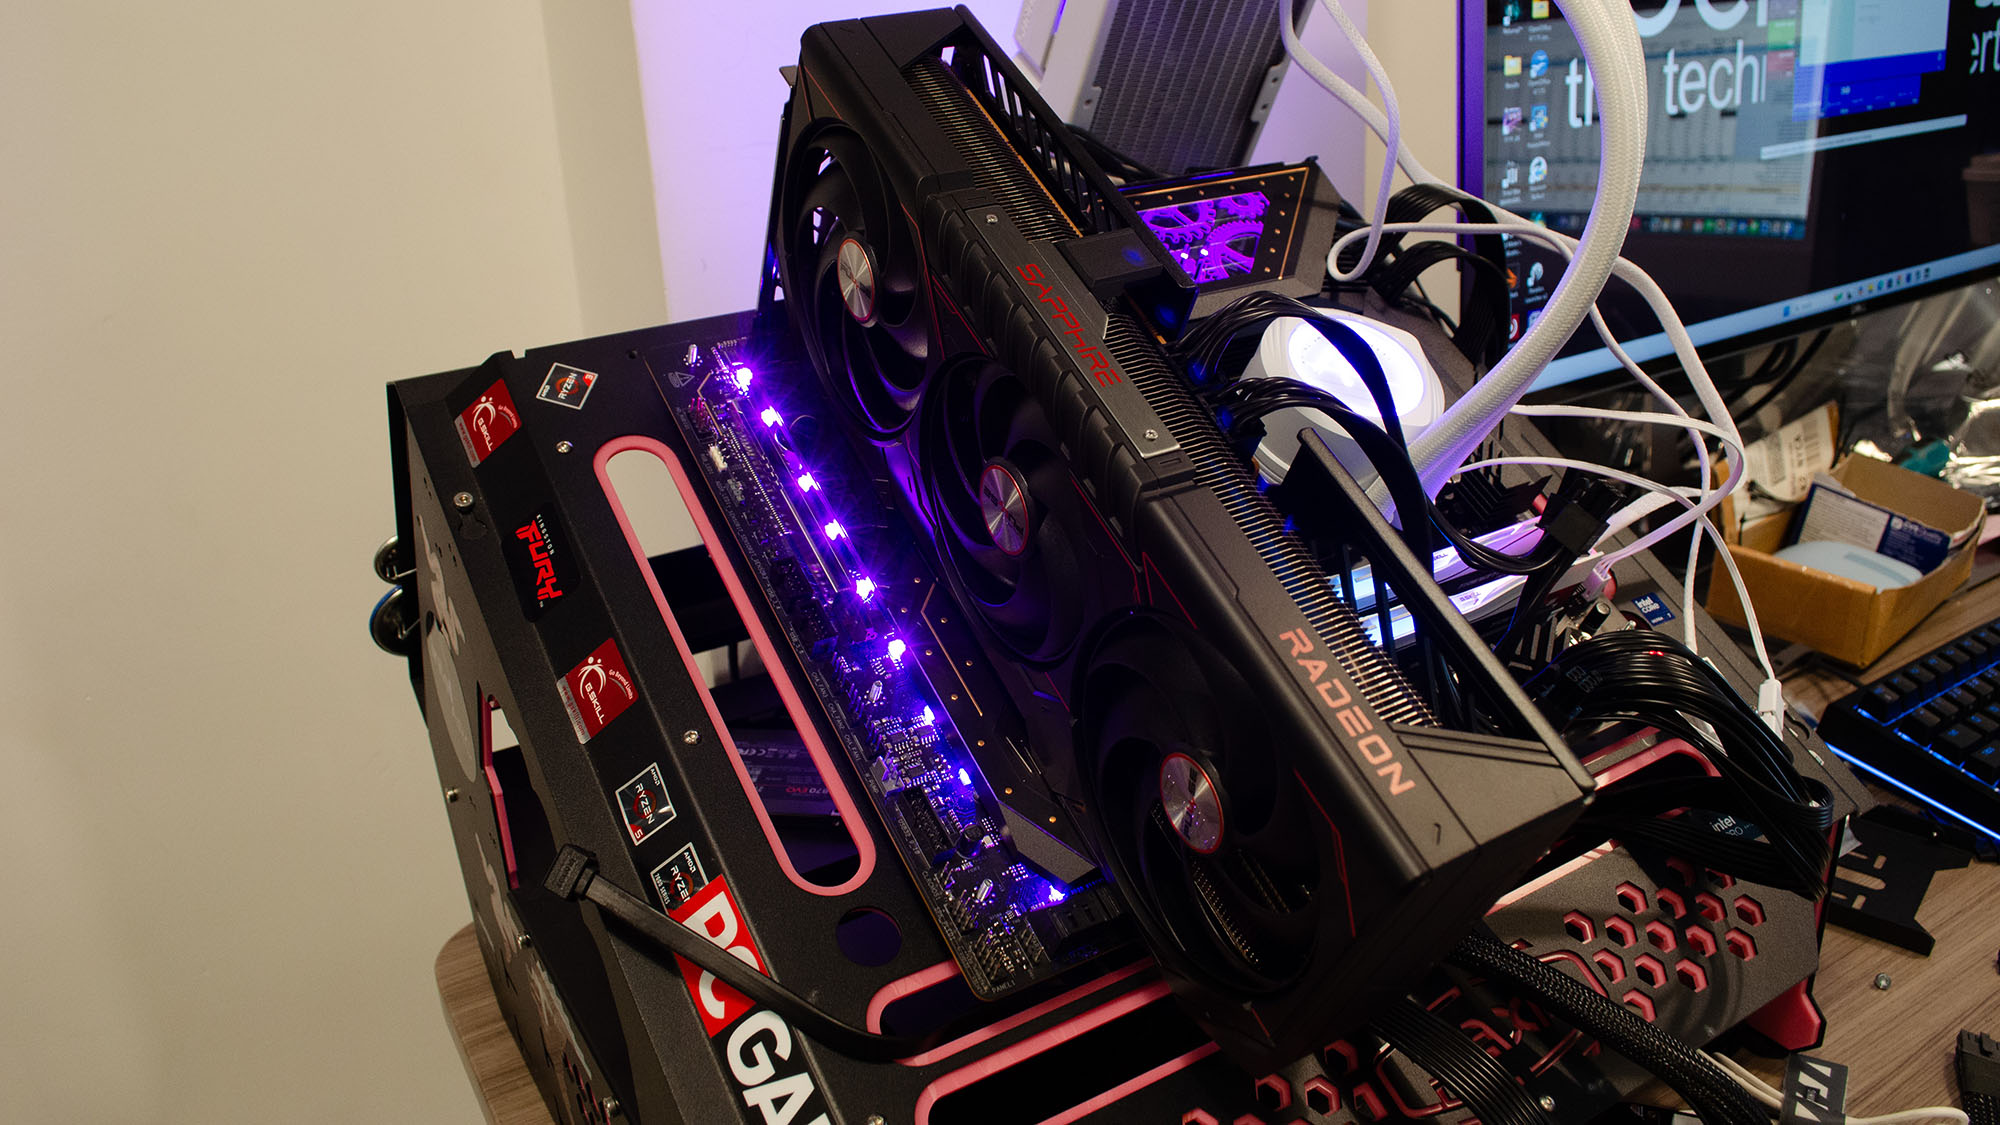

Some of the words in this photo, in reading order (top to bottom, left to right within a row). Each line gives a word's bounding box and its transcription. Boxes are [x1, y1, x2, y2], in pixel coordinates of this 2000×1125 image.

[1016, 263, 1122, 388] SAPPHIRE
[558, 372, 578, 400] RYZEN
[477, 417, 494, 452] G.SKILL
[536, 513, 555, 556] KINGSTON
[515, 519, 563, 601] FURY
[585, 682, 605, 725] G.SKILL
[1279, 627, 1416, 796] RADEON
[635, 782, 655, 825] RYZEN
[1709, 815, 1736, 832] intel
[634, 828, 644, 839] 5
[726, 1009, 832, 1125] GA
